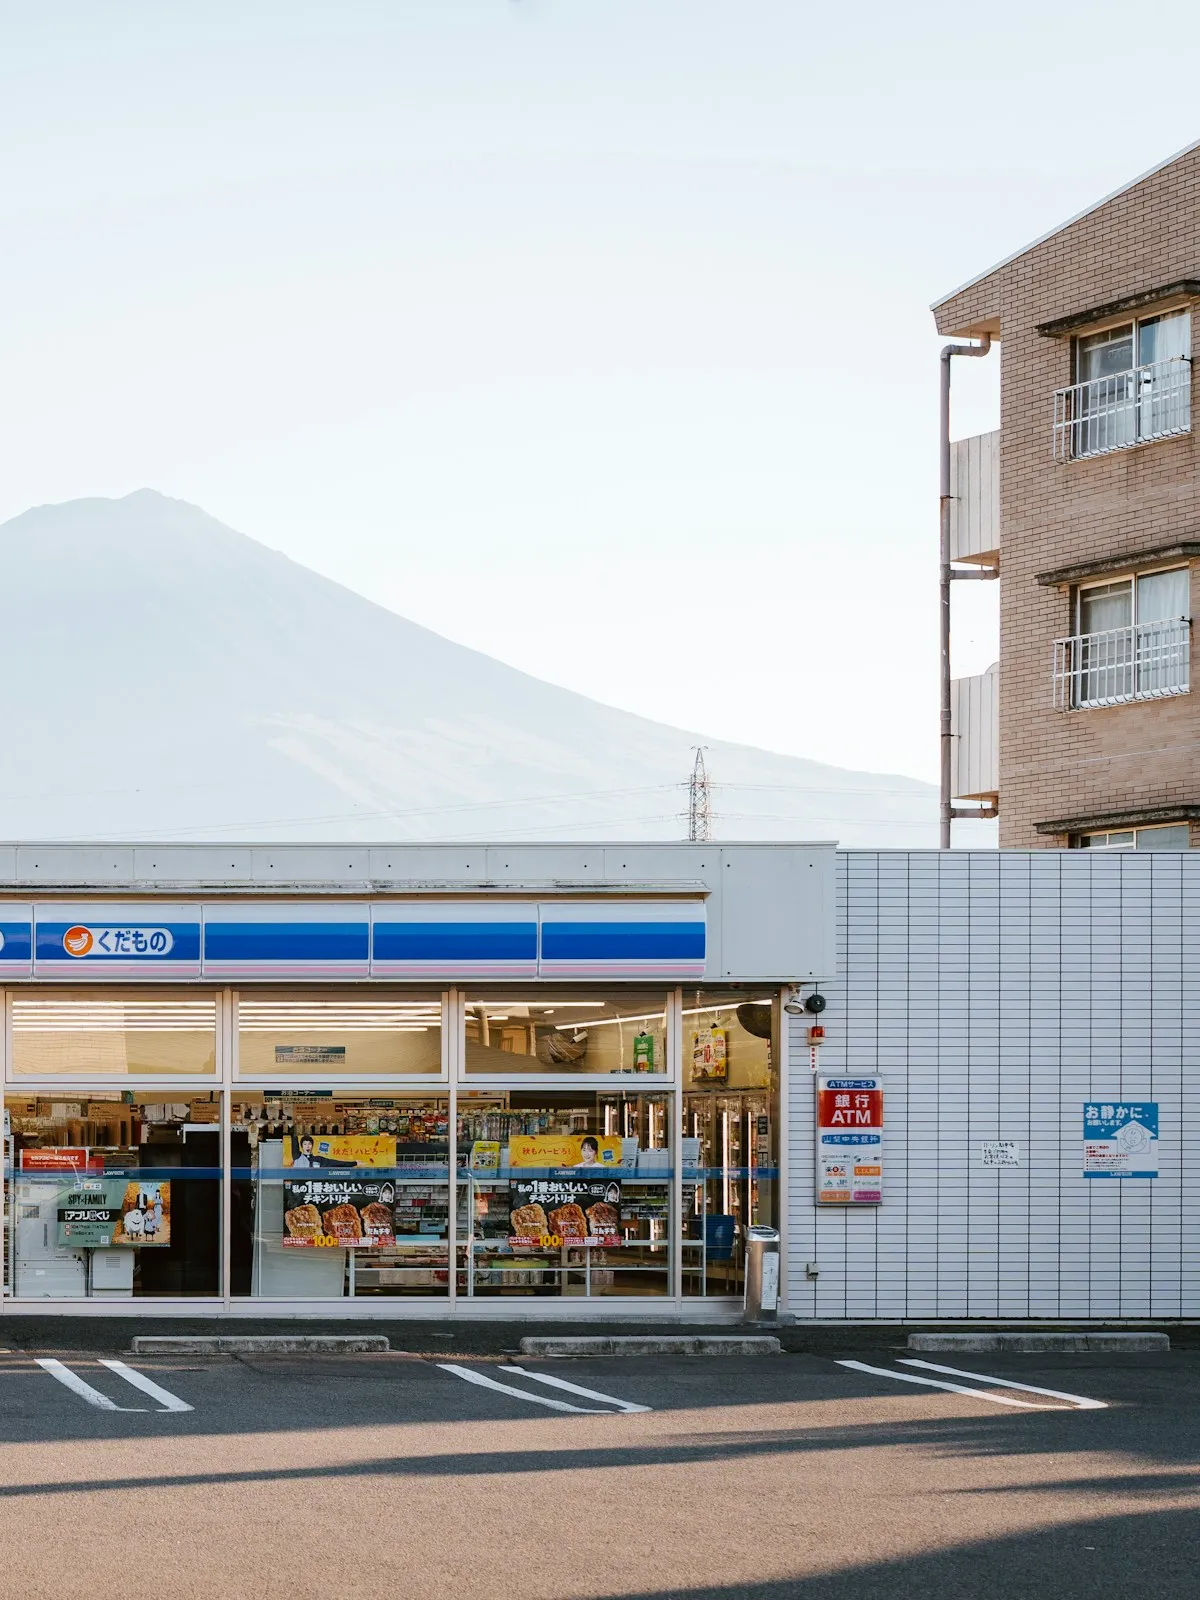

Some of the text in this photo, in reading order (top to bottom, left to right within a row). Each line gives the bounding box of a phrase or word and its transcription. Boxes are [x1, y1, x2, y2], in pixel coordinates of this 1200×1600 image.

[97, 930, 167, 952] くだもの
[835, 1094, 870, 1108] 銀行
[831, 1110, 871, 1124] ATM
[1085, 1105, 1143, 1119] お静かに
[292, 1181, 362, 1193] 私の1番おいしい
[518, 1181, 588, 1192] 私の1番おいしい
[68, 1194, 107, 1206] SPY×FAMILY
[303, 1195, 351, 1204] チキントリオ
[529, 1194, 577, 1203] チキントリオ
